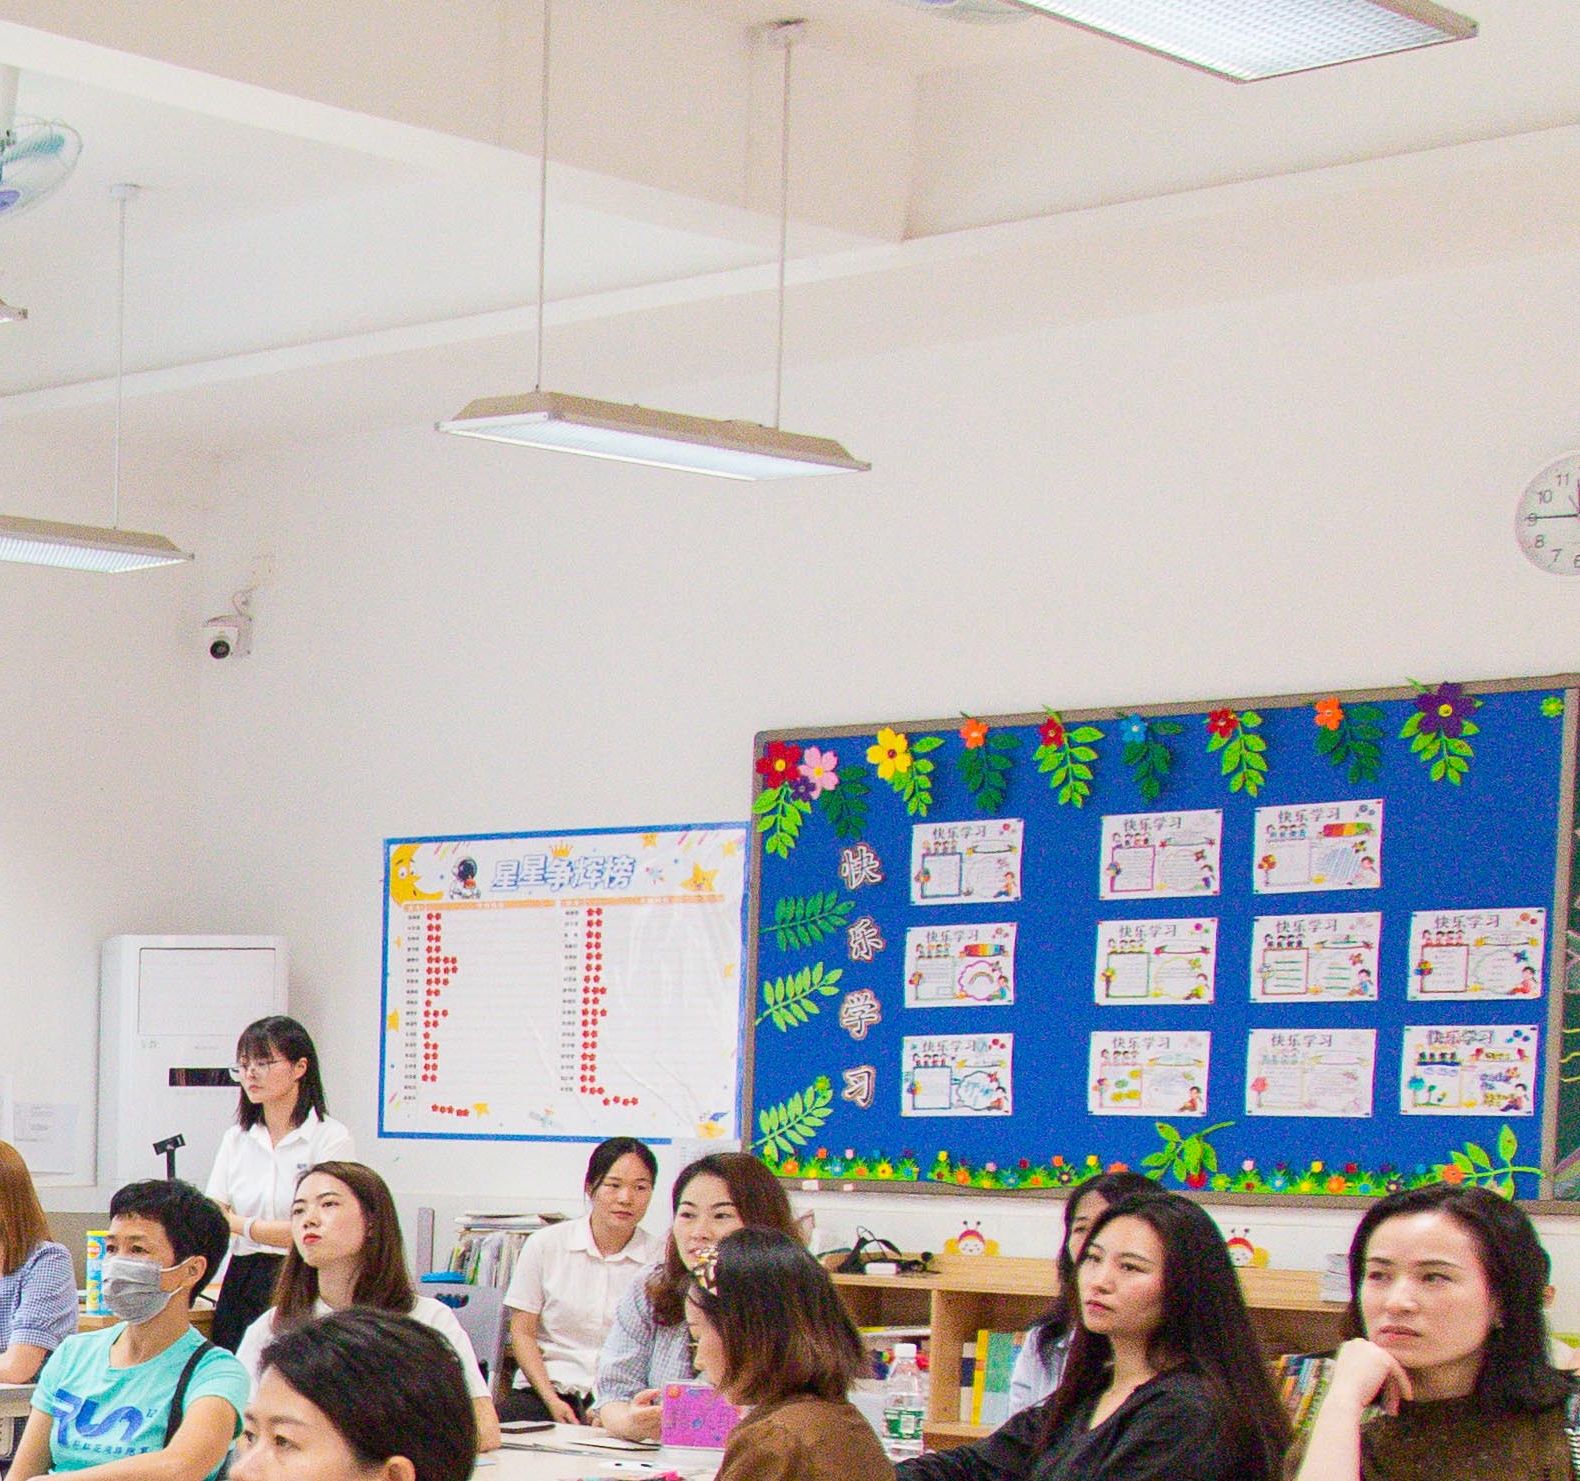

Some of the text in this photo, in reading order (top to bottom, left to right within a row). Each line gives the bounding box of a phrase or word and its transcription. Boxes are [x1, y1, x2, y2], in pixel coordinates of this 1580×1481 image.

[1277, 806, 1341, 823] 快乐学习
[931, 824, 988, 840] 快乐学习
[1123, 815, 1182, 833] 快乐学习
[1275, 918, 1338, 934] 快乐学习
[1433, 914, 1500, 930] 快乐学习
[925, 929, 980, 944] 快乐学习
[1119, 923, 1178, 939] 快乐学习
[1112, 1036, 1171, 1050] 快乐学习
[1271, 1032, 1333, 1048] 快乐学习
